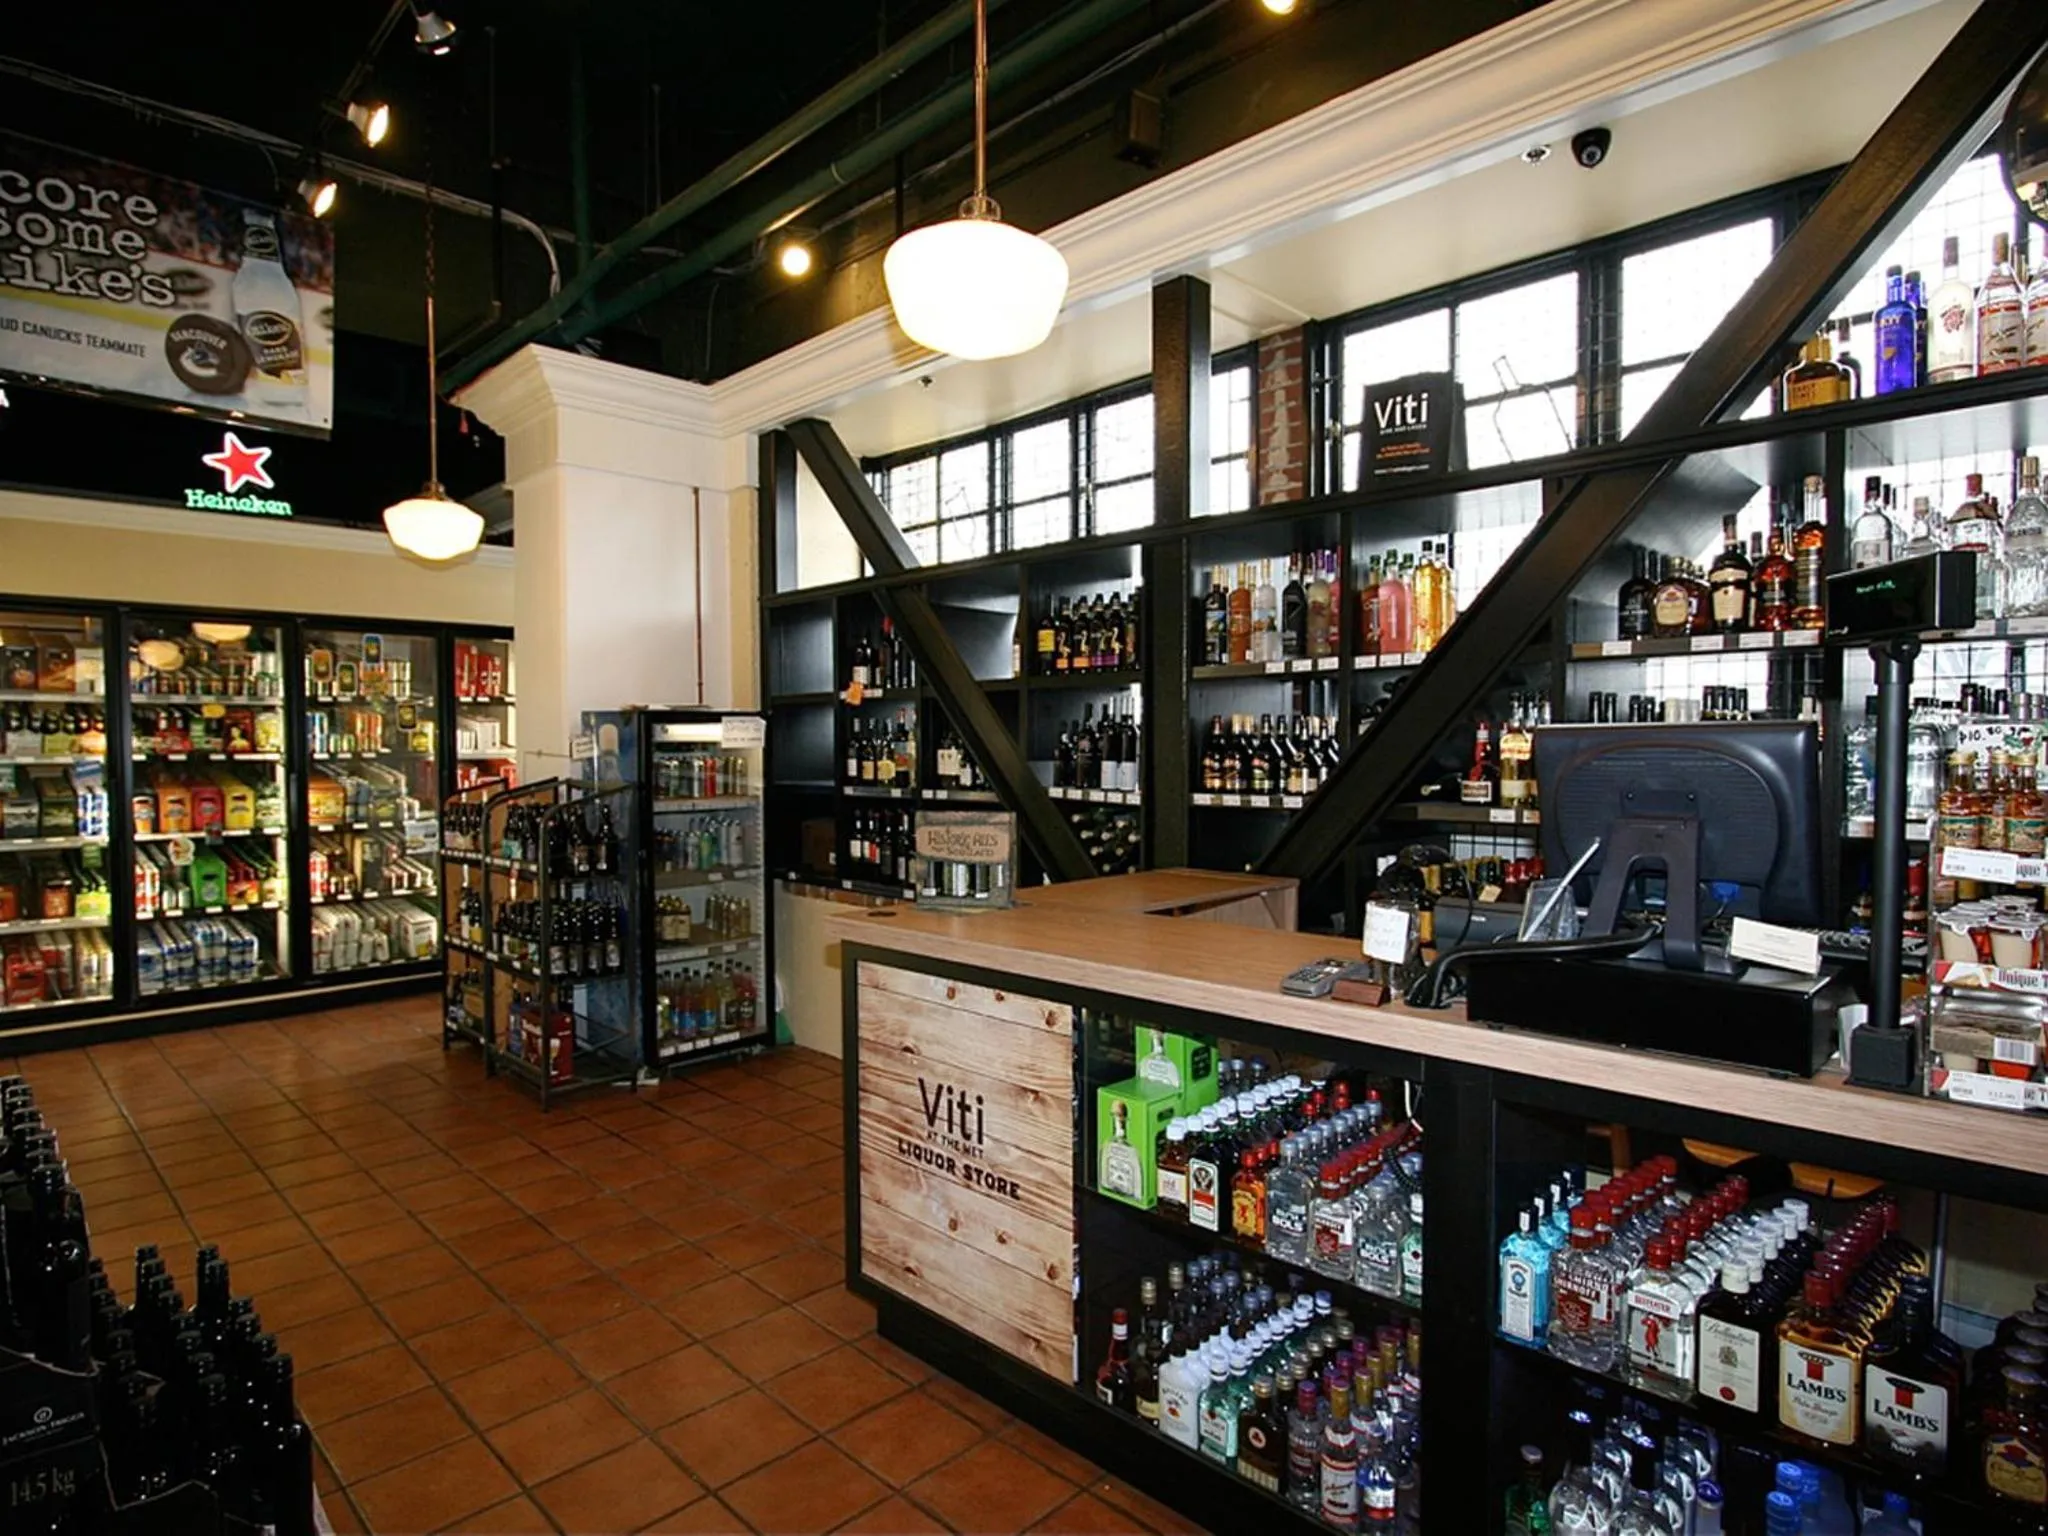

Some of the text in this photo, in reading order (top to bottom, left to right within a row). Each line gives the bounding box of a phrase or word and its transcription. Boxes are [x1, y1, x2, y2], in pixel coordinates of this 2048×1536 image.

[0, 245, 175, 306] ike's
[22, 321, 83, 345] CANUCKS
[85, 333, 147, 358] TEAMMATE
[170, 328, 228, 350] VANCOUVER
[1374, 393, 1429, 429] Viti
[184, 489, 293, 516] Heineken
[1998, 969, 2039, 988] Unique
[918, 1077, 984, 1145] Viti
[927, 1130, 984, 1159] AT THE MET
[898, 1138, 1021, 1200] LIQUOR STORE
[1787, 1372, 1847, 1403] LAMB'S
[1873, 1398, 1939, 1433] LAMB'S
[51, 1466, 76, 1498] kg
